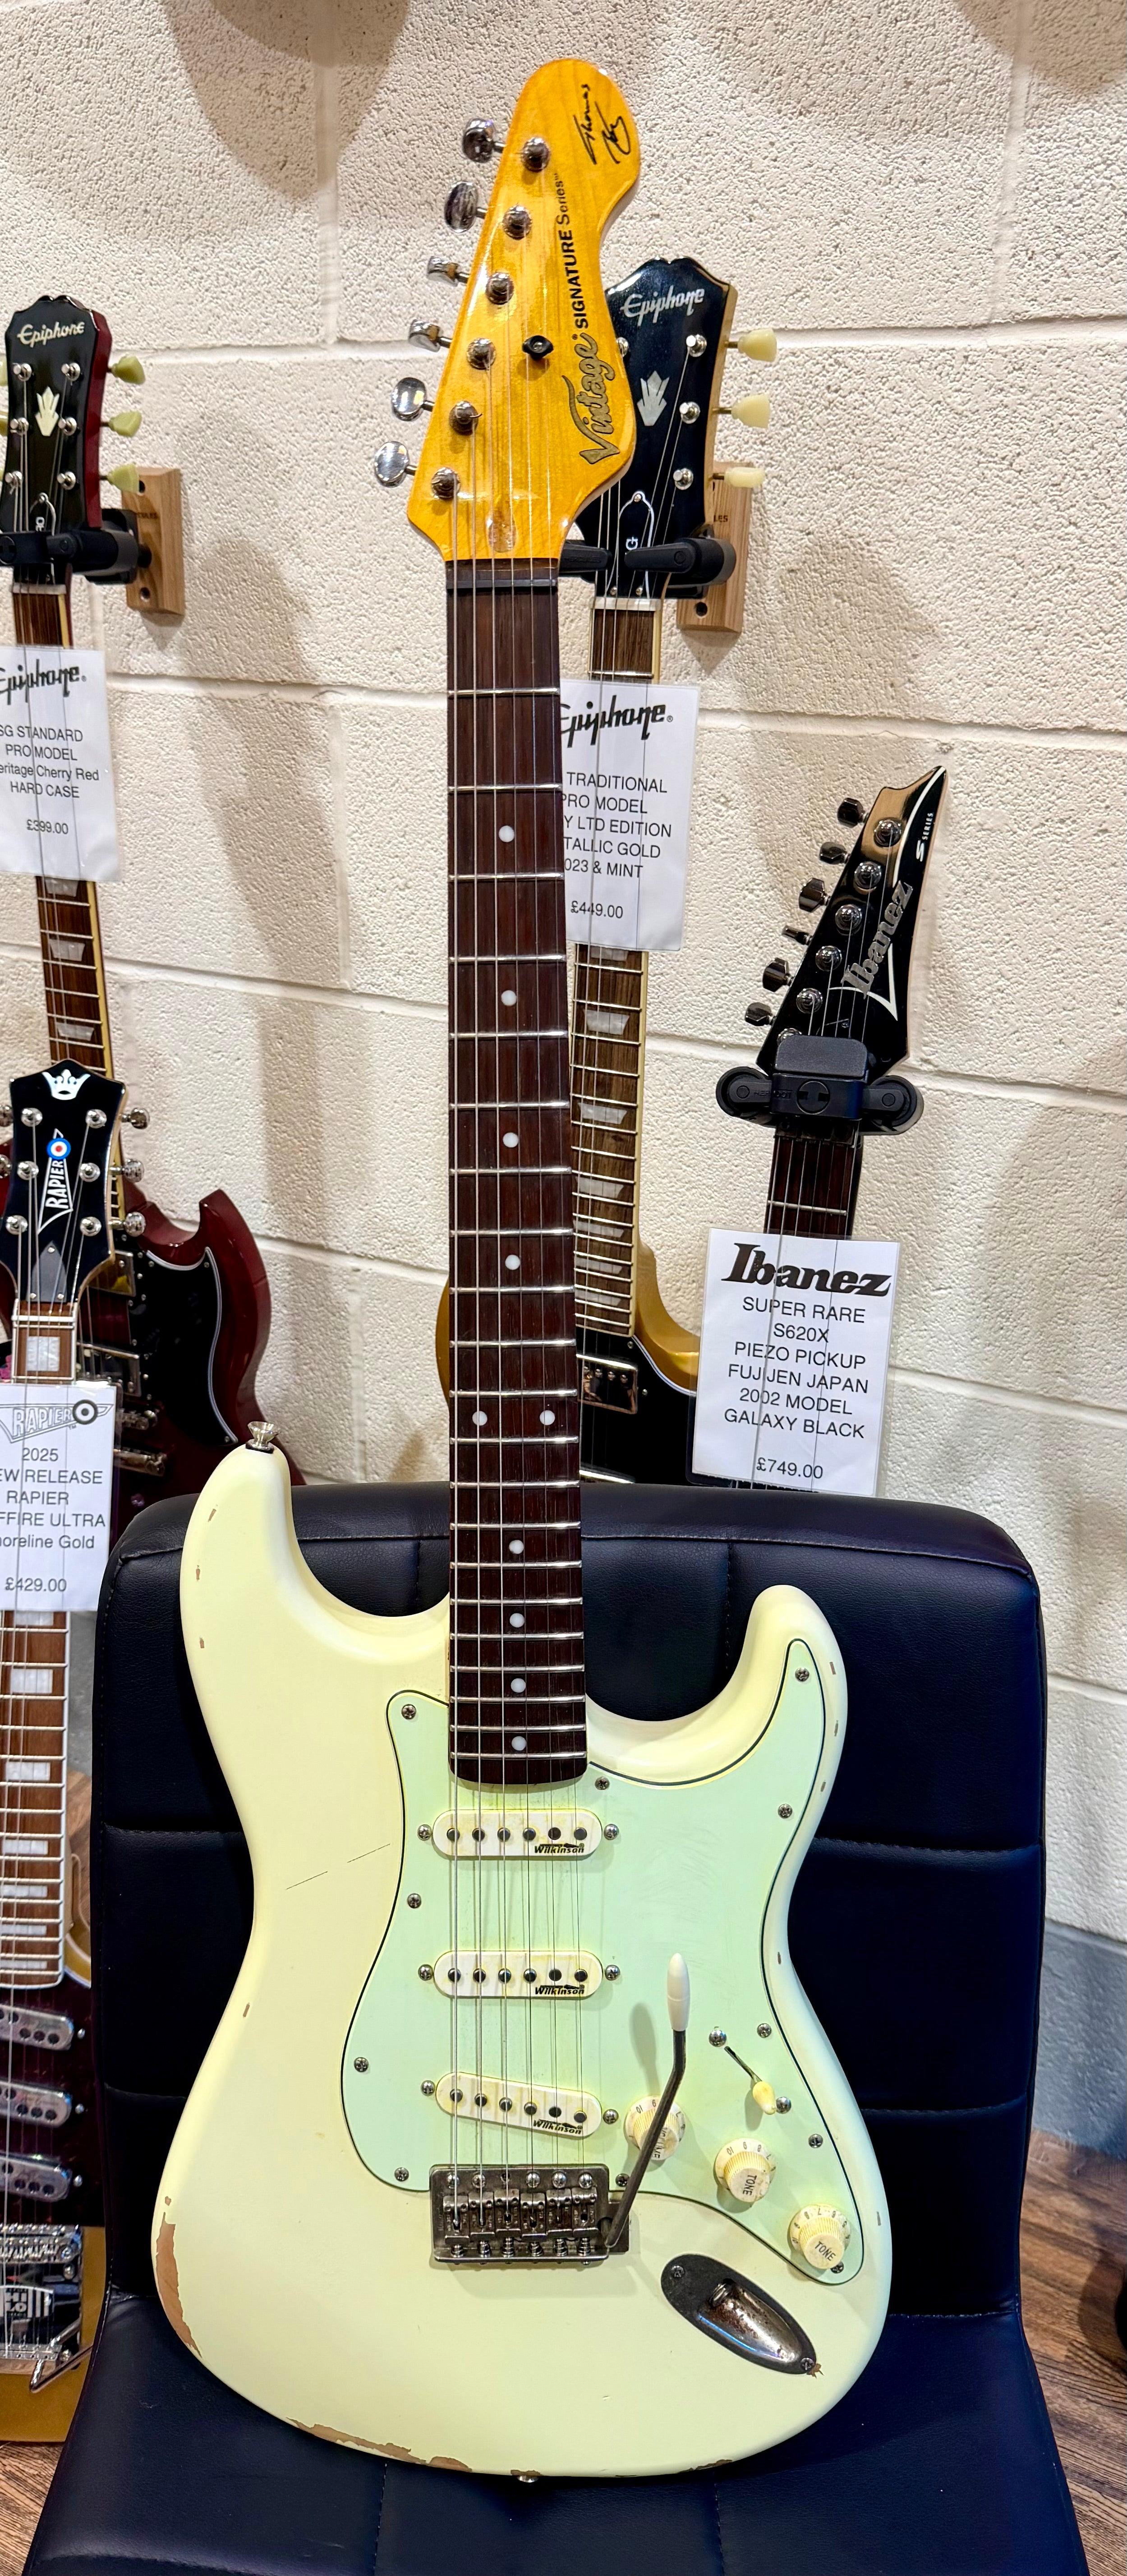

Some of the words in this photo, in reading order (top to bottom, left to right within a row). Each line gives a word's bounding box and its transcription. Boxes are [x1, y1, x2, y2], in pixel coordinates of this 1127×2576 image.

[558, 230, 588, 329] SIGNATURE
[620, 287, 704, 326] Epiphone
[17, 322, 85, 348] Epiphone
[17, 726, 83, 742] STANDARD
[5, 744, 32, 757] PRO
[35, 746, 78, 761] MODEL
[37, 765, 72, 782] Cherry
[76, 768, 99, 781] Red
[566, 772, 667, 793] TRADITIONAL
[10, 781, 43, 795] HARD
[46, 784, 80, 798] CASE
[596, 796, 648, 814] MODEL
[27, 819, 69, 835] £399.00
[578, 816, 605, 831] LTD
[610, 819, 672, 837] EDITION
[922, 812, 934, 840] SERIES
[617, 842, 661, 858] GOLD
[593, 860, 602, 874] &
[607, 862, 644, 878] MINT
[570, 901, 623, 919] £449.00
[842, 881, 913, 999] Ibanez
[45, 1160, 68, 1209] RAPIER
[721, 1242, 892, 1297] Ibanez
[742, 1297, 805, 1319] SUPER
[812, 1304, 865, 1323] RARE
[773, 1323, 829, 1343] S620X
[734, 1341, 790, 1362] PIEZO
[796, 1349, 866, 1369] PICKUP
[807, 1374, 868, 1393] JAPAN
[739, 1388, 780, 1406] 2002
[786, 1394, 852, 1415] MODEL
[13, 1407, 72, 1437] RAPIER
[724, 1408, 797, 1431] GALAXY
[803, 1419, 865, 1439] BLACK
[23, 1448, 58, 1462] 2025
[25, 1469, 103, 1484] RELEASE
[756, 1457, 823, 1479] £749.00
[7, 1490, 69, 1505] RAPIER
[50, 1513, 106, 1527] ULTRA
[59, 1535, 94, 1549] Gold
[5, 1577, 67, 1592] £429.00
[743, 2175, 757, 2195] TONE
[815, 2241, 836, 2261] TONE
